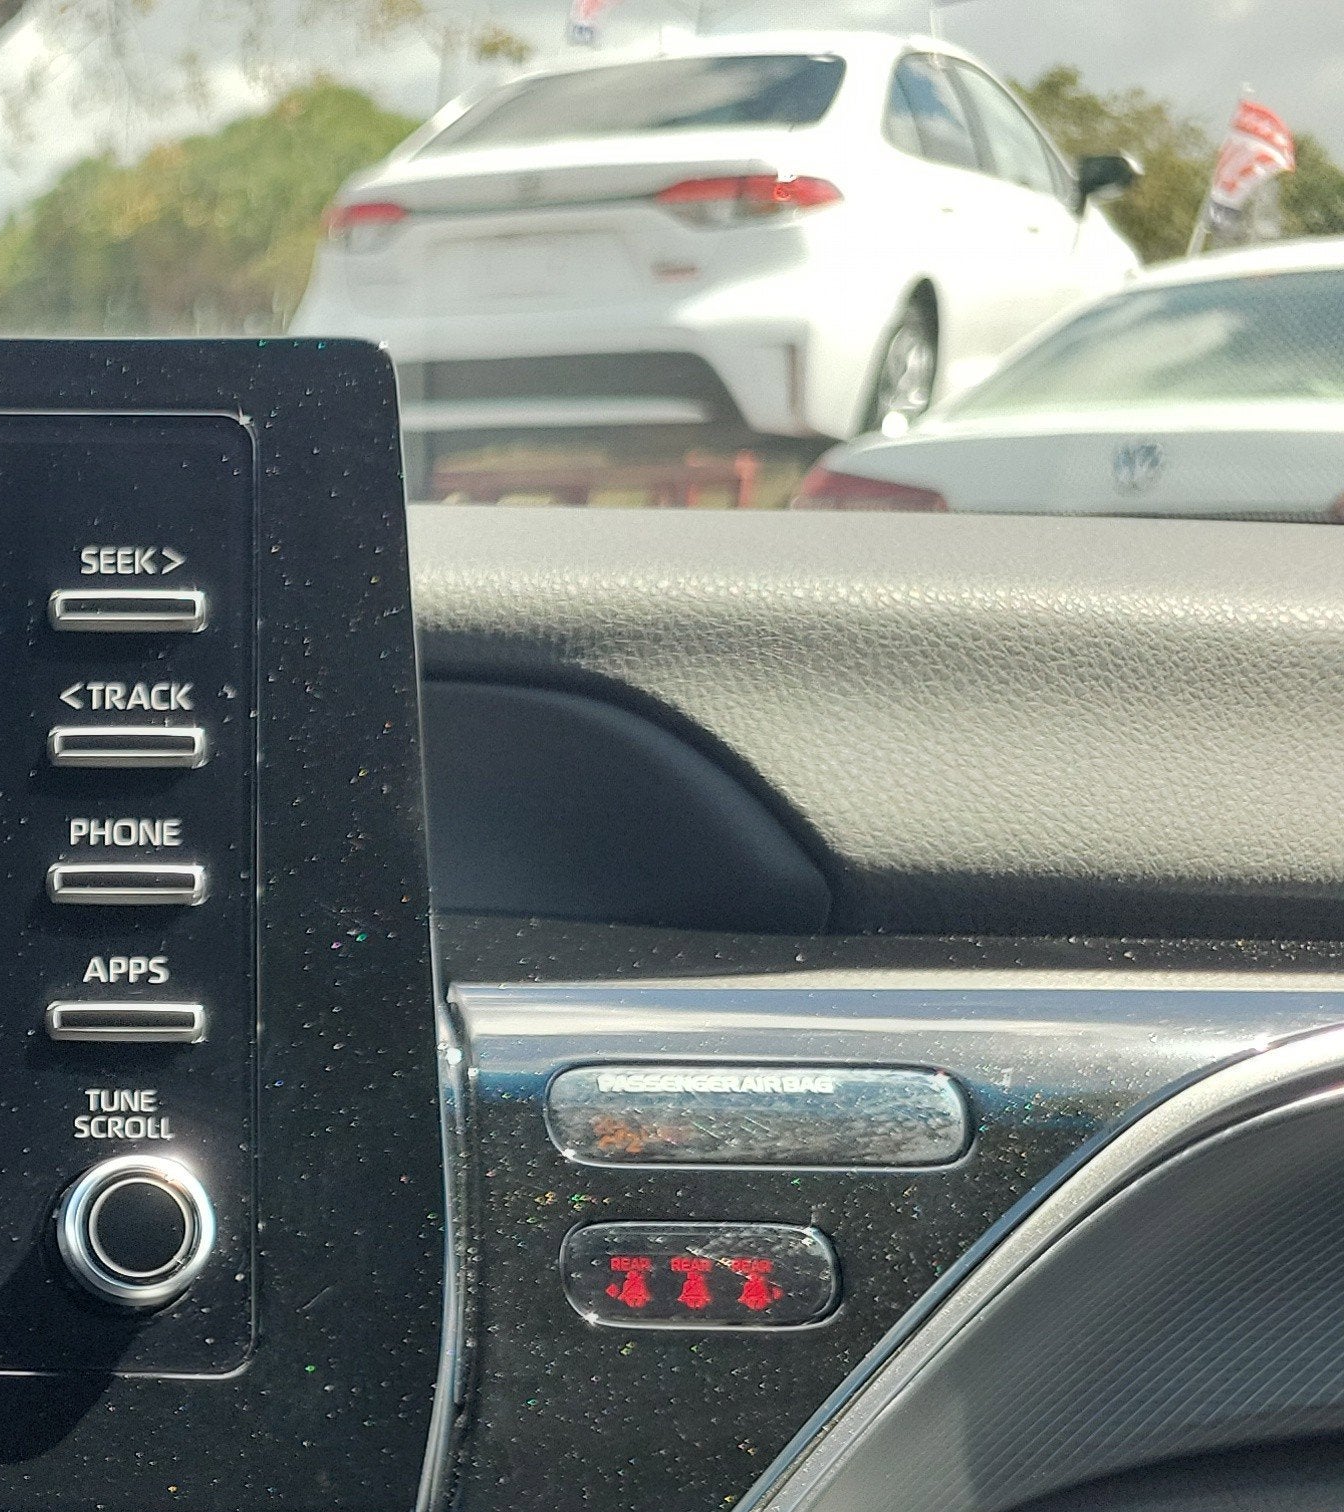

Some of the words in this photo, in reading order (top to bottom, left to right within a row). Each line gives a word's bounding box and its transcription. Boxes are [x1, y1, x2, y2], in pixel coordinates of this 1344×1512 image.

[71, 819, 181, 846] PHONE
[83, 957, 169, 983] APPS
[598, 1073, 738, 1093] PASSENGER
[783, 1075, 834, 1094] BAG
[85, 1089, 156, 1112] TUNE
[75, 1116, 175, 1141] SCROLL
